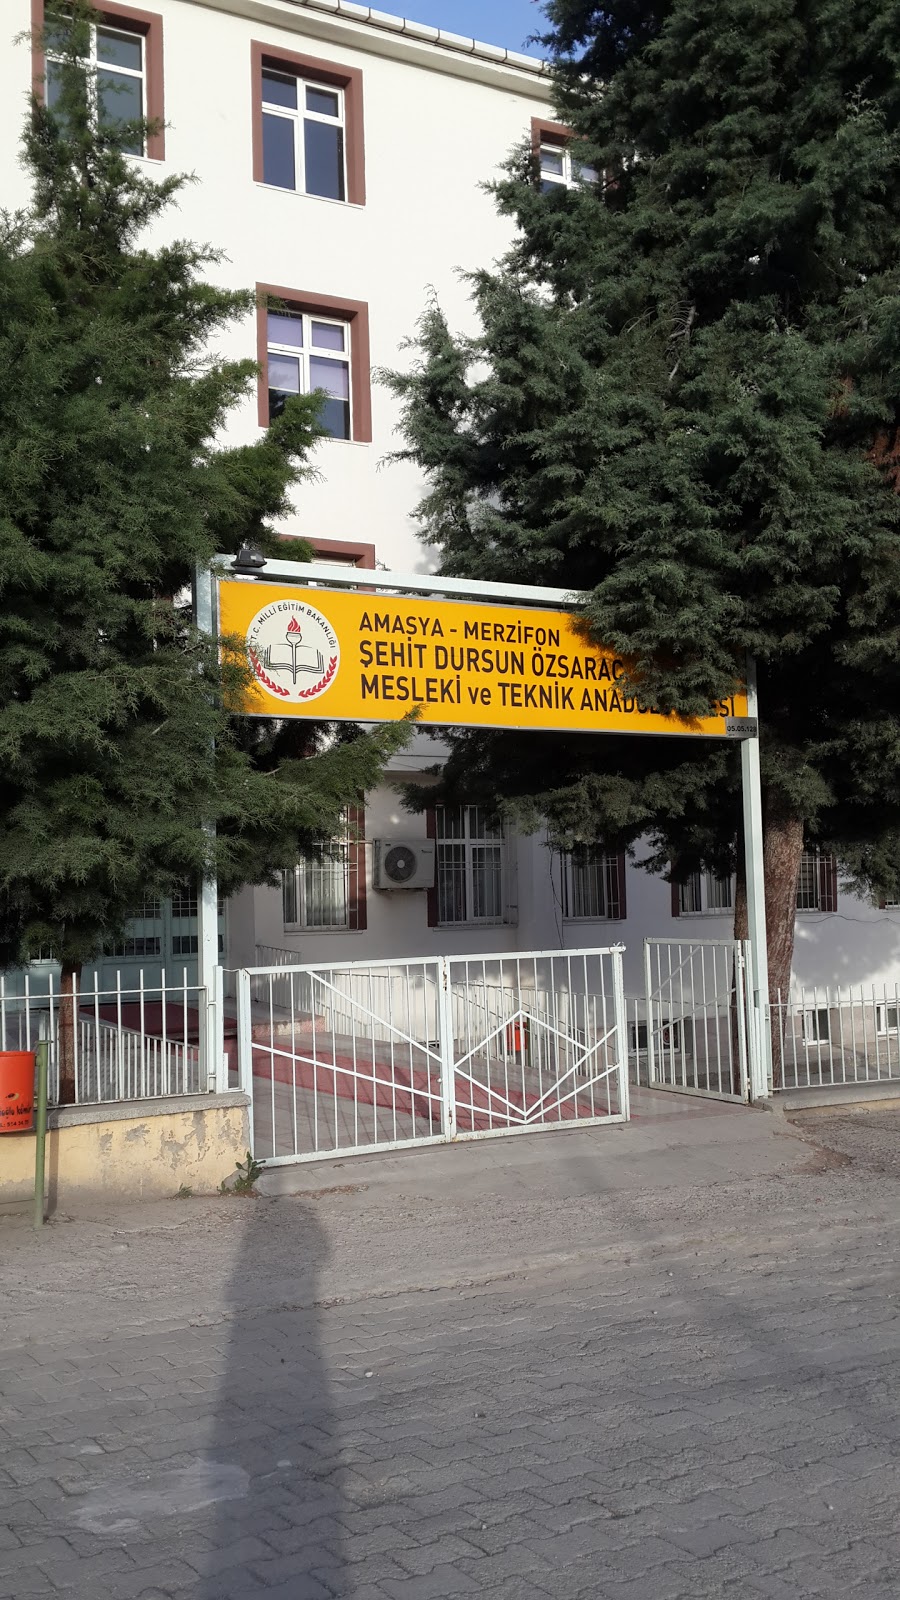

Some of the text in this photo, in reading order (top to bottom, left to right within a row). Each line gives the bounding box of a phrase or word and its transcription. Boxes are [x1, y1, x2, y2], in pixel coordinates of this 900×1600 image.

[250, 602, 336, 648] T.C. MİLLİ EĞİTİM BAKANLIĞI
[359, 612, 444, 637] AMASYA
[464, 620, 560, 647] MERZİFON
[359, 636, 427, 668] ŞEHİT
[435, 645, 525, 675] DURSUN
[361, 674, 461, 704] MESLEKİ
[467, 687, 492, 706] ve
[497, 681, 575, 710] TEKNİK
